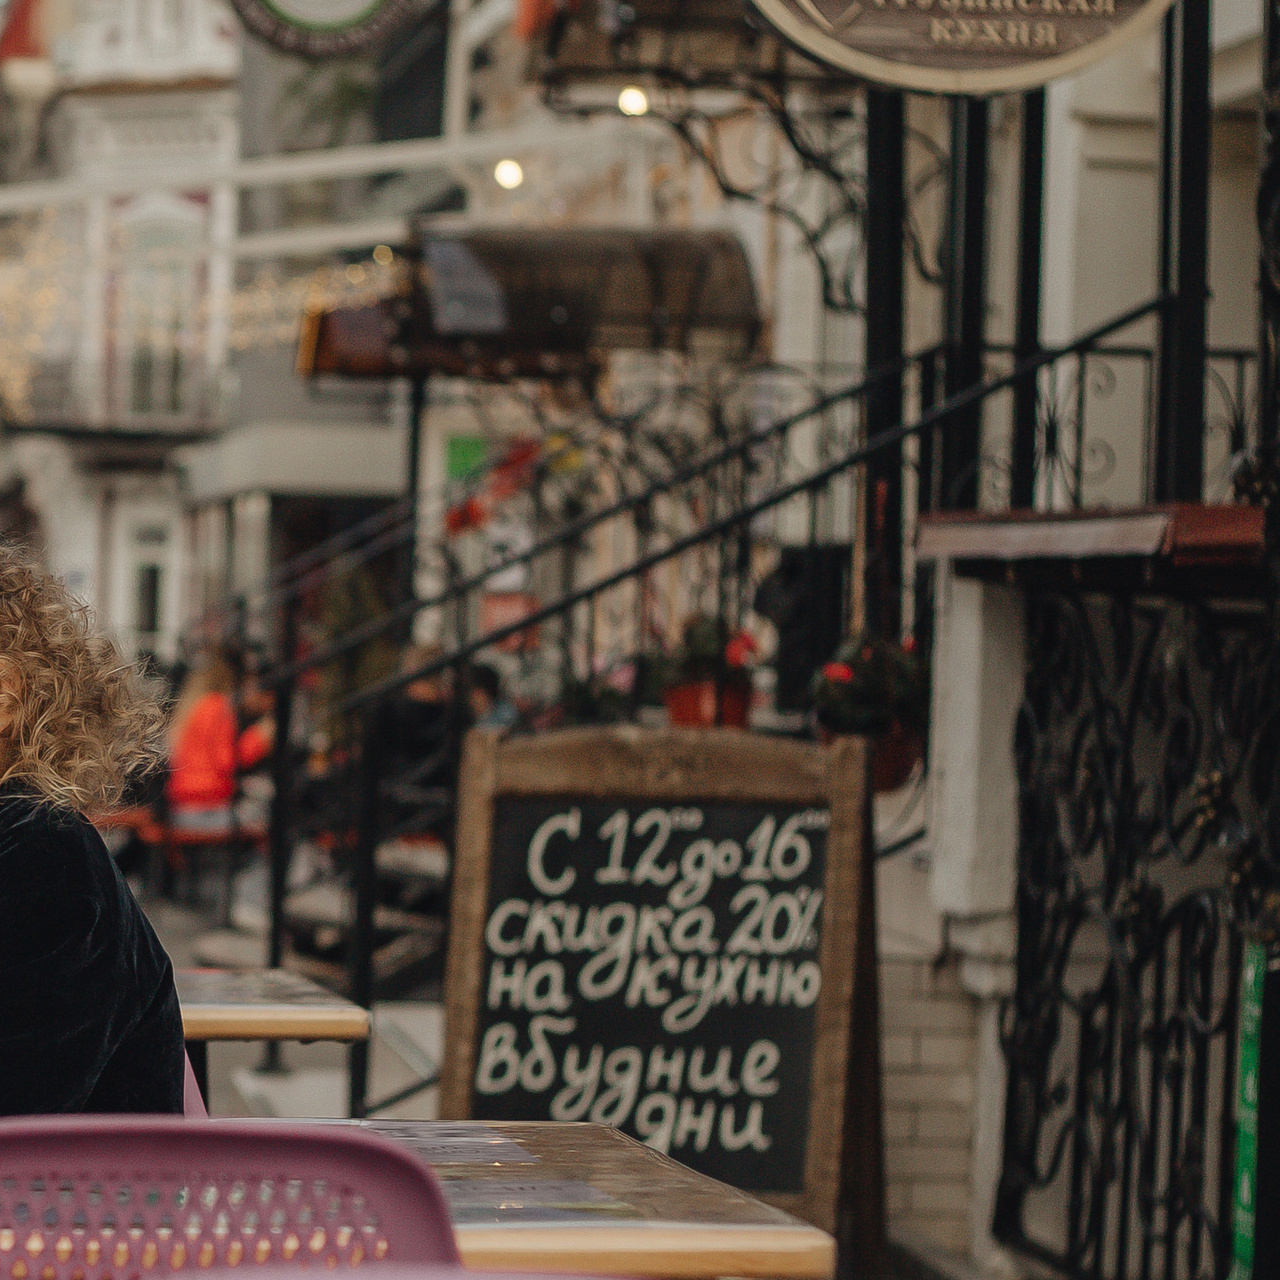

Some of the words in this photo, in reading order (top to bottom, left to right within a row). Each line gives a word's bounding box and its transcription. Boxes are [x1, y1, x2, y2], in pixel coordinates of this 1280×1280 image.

[928, 17, 1058, 48] КУХНЯ
[485, 898, 719, 1000] скидка
[725, 883, 823, 955] 20%
[487, 959, 571, 1012] на
[625, 952, 821, 1033] кухню
[635, 1091, 772, 1154] дни
